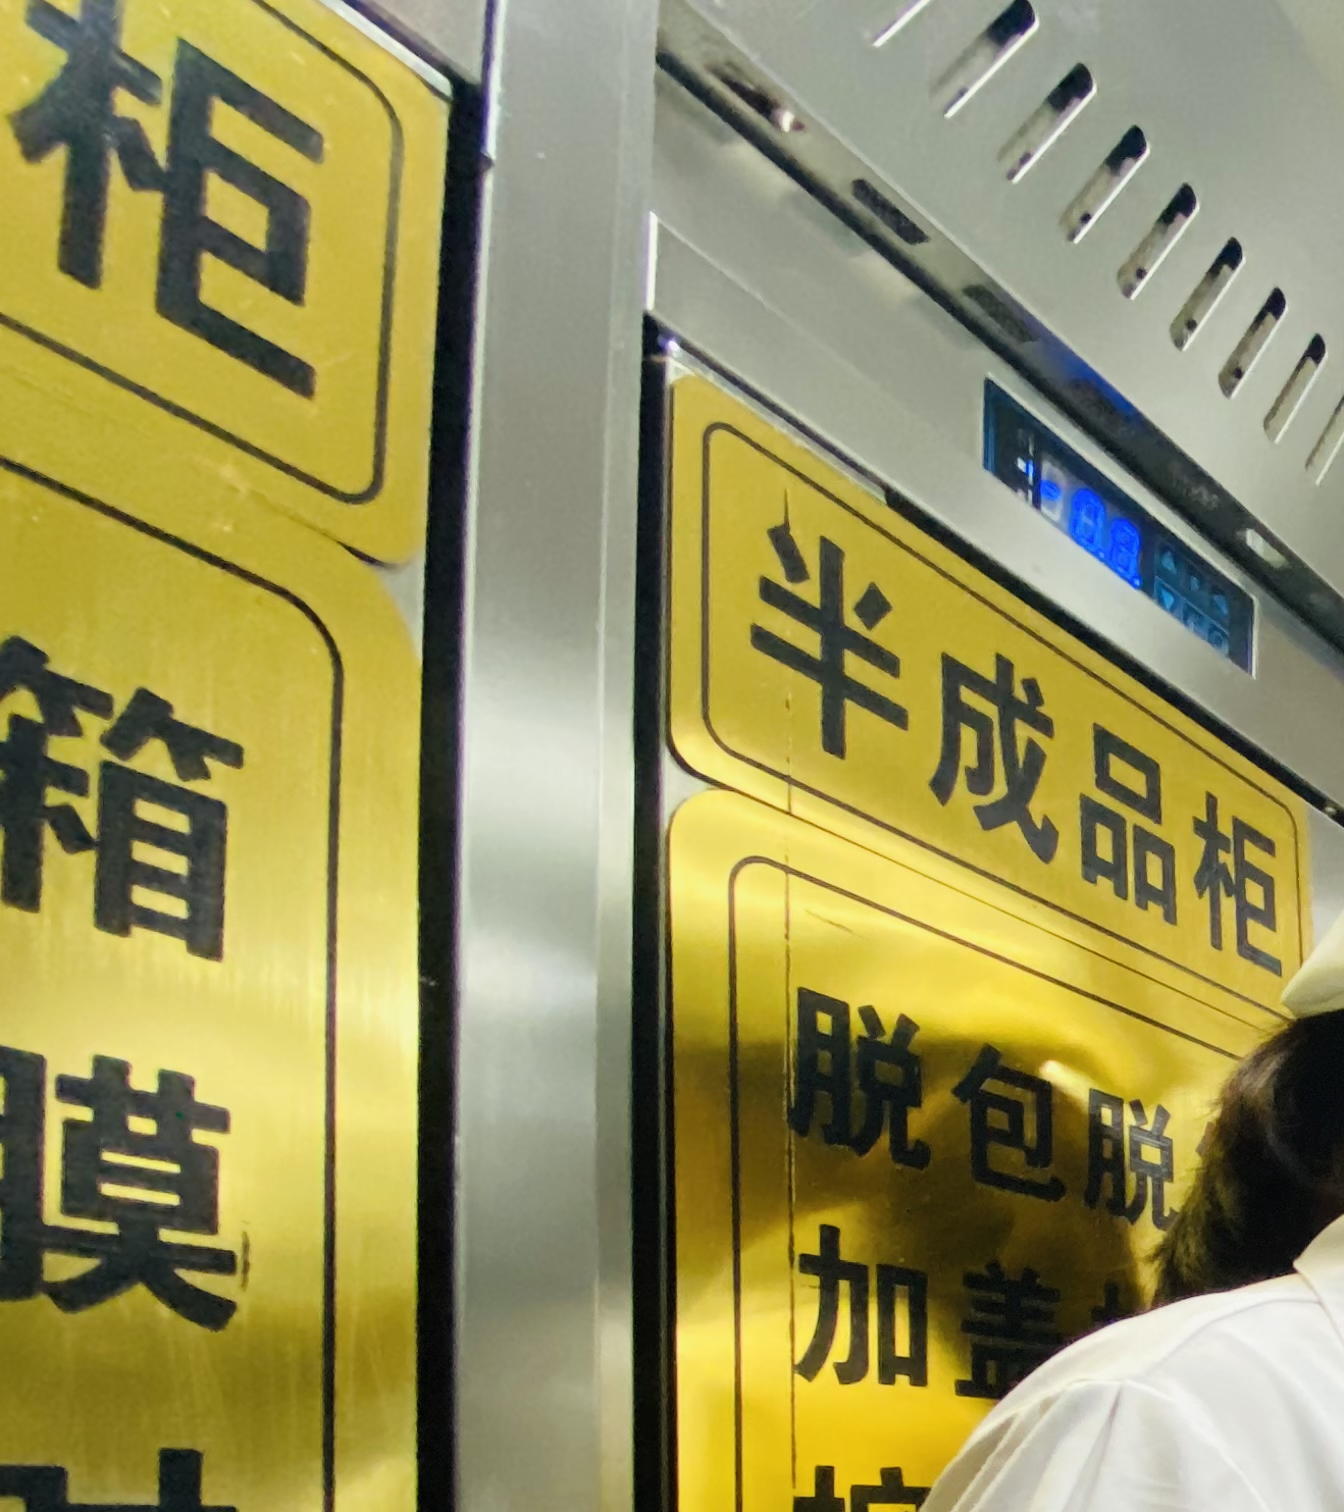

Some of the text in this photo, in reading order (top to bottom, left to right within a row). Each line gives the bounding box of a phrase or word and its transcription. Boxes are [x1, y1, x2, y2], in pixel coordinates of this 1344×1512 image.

[7, 0, 324, 400] 柜
[0, 635, 245, 962] 箱
[749, 524, 1283, 977] 半成品柜
[0, 1045, 238, 1332] 膜
[787, 987, 1217, 1232] 脱包脱
[793, 1224, 1122, 1400] 加盖
